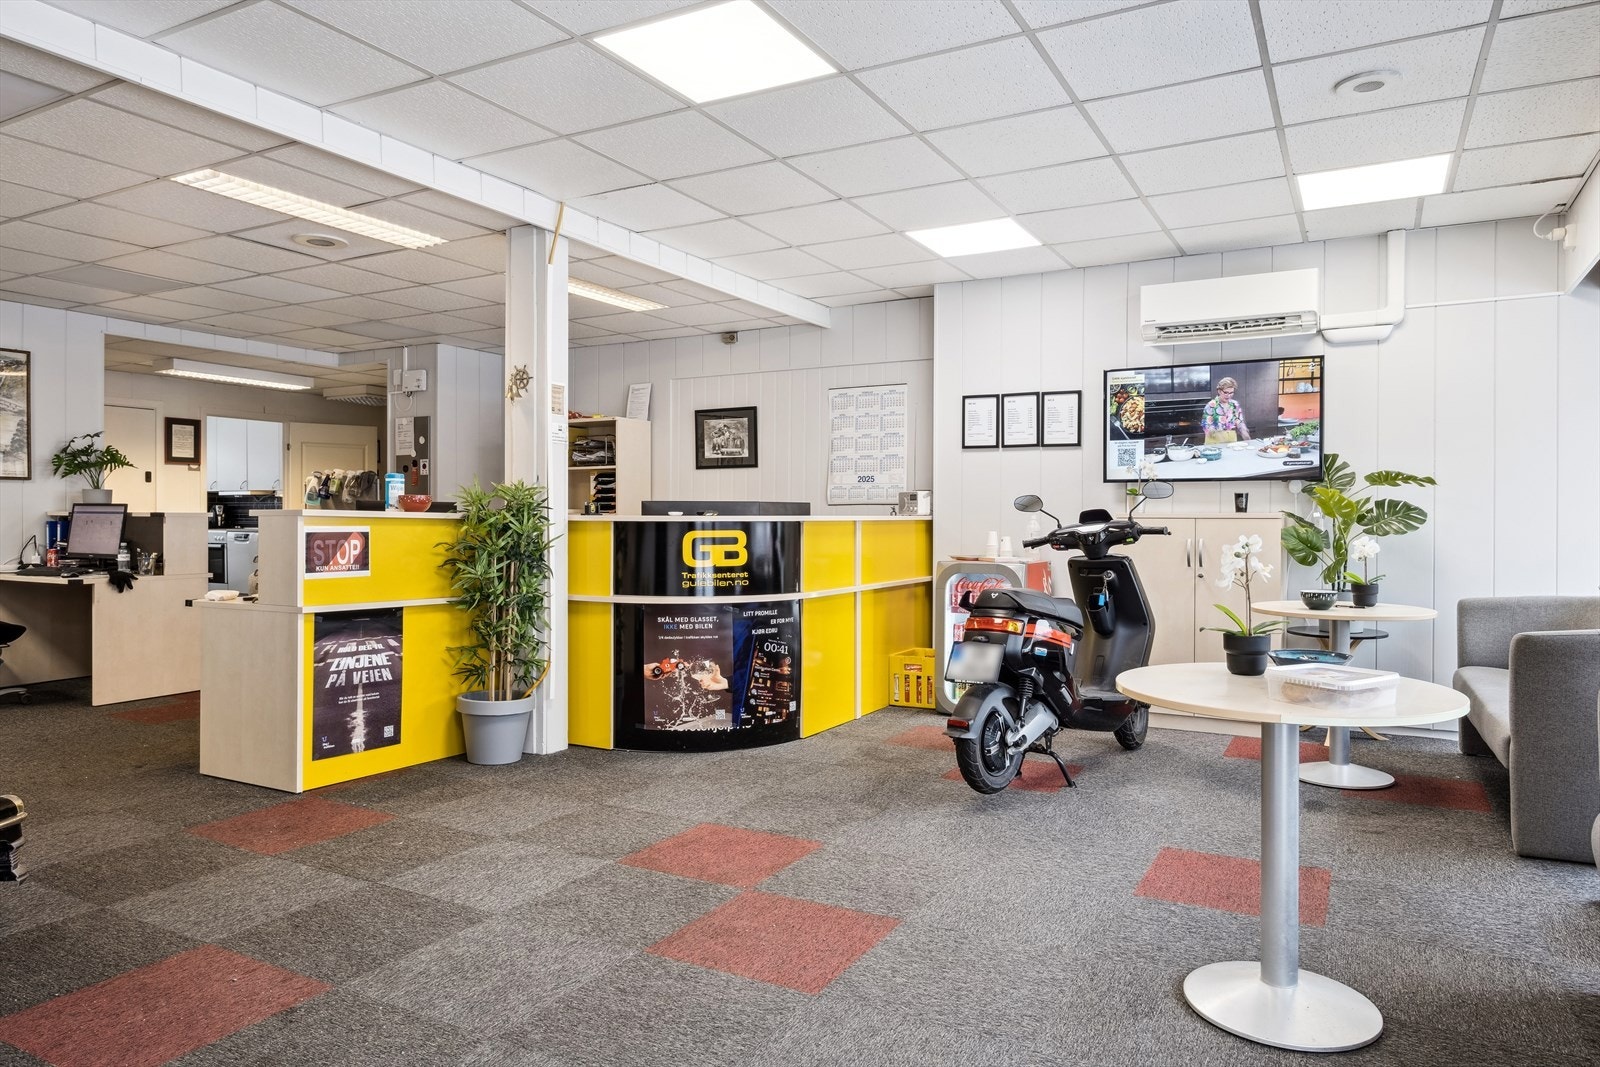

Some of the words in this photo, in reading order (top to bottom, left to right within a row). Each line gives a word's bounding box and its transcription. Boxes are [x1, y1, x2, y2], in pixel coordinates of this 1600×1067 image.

[857, 475, 875, 483] 2025
[313, 539, 361, 565] STOP
[682, 529, 748, 568] GB
[681, 571, 749, 579] Trafikksenteret
[681, 579, 749, 588] gulebiler.no
[657, 615, 674, 623] SKÅL
[763, 642, 789, 655] 00:41
[329, 653, 393, 672] LINJENE
[325, 669, 346, 689] PÅ
[352, 668, 393, 685] VEIEN
